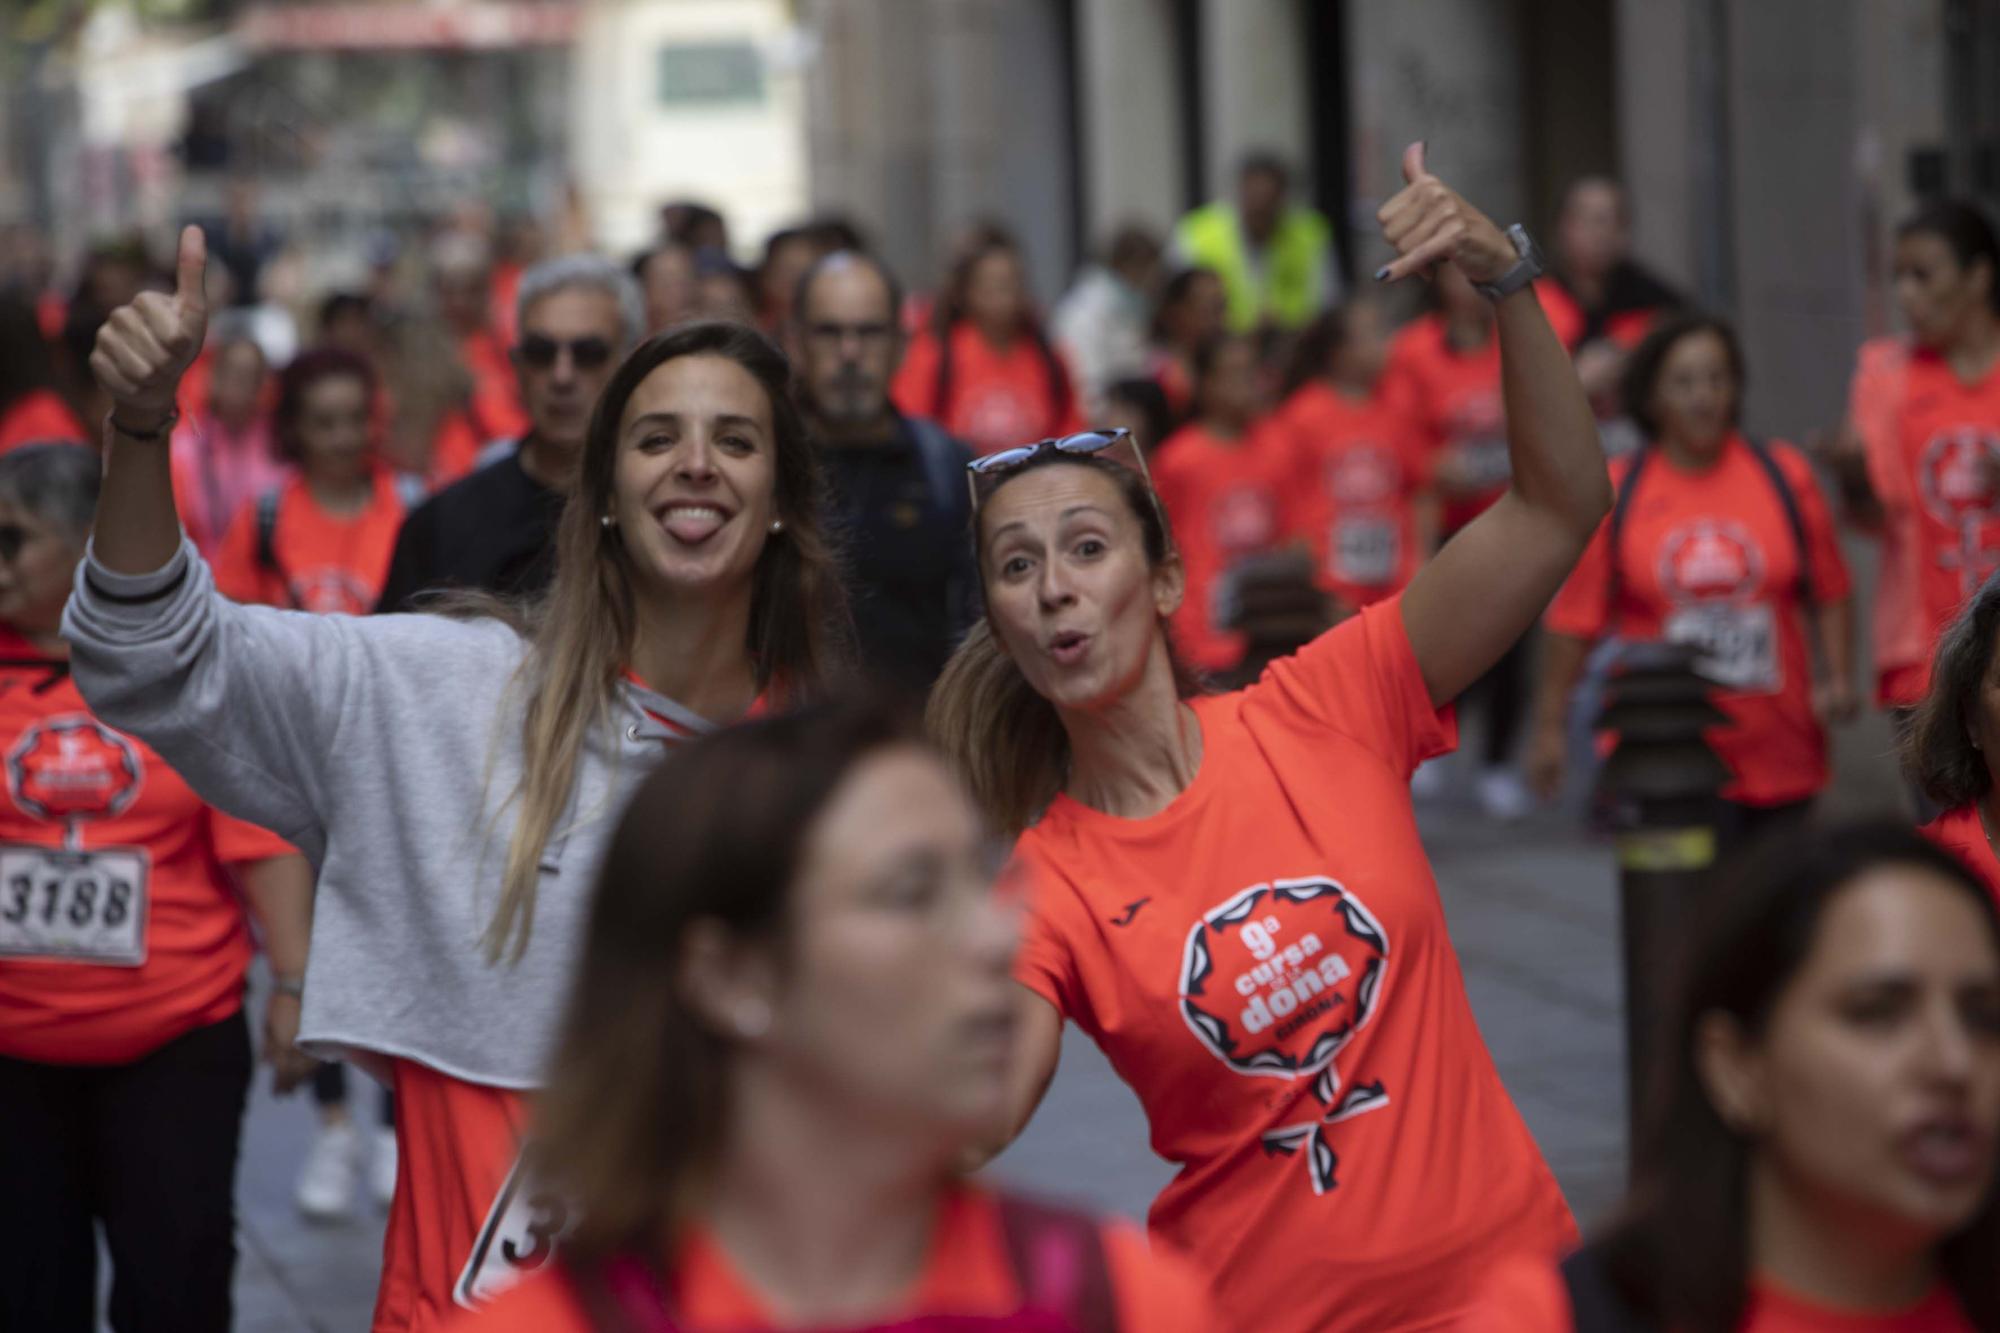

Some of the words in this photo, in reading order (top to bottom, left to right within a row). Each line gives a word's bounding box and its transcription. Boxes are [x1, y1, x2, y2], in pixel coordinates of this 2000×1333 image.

[3, 875, 131, 926] 3188
[1235, 934, 1322, 995] cursa
[1242, 953, 1351, 1034] dona
